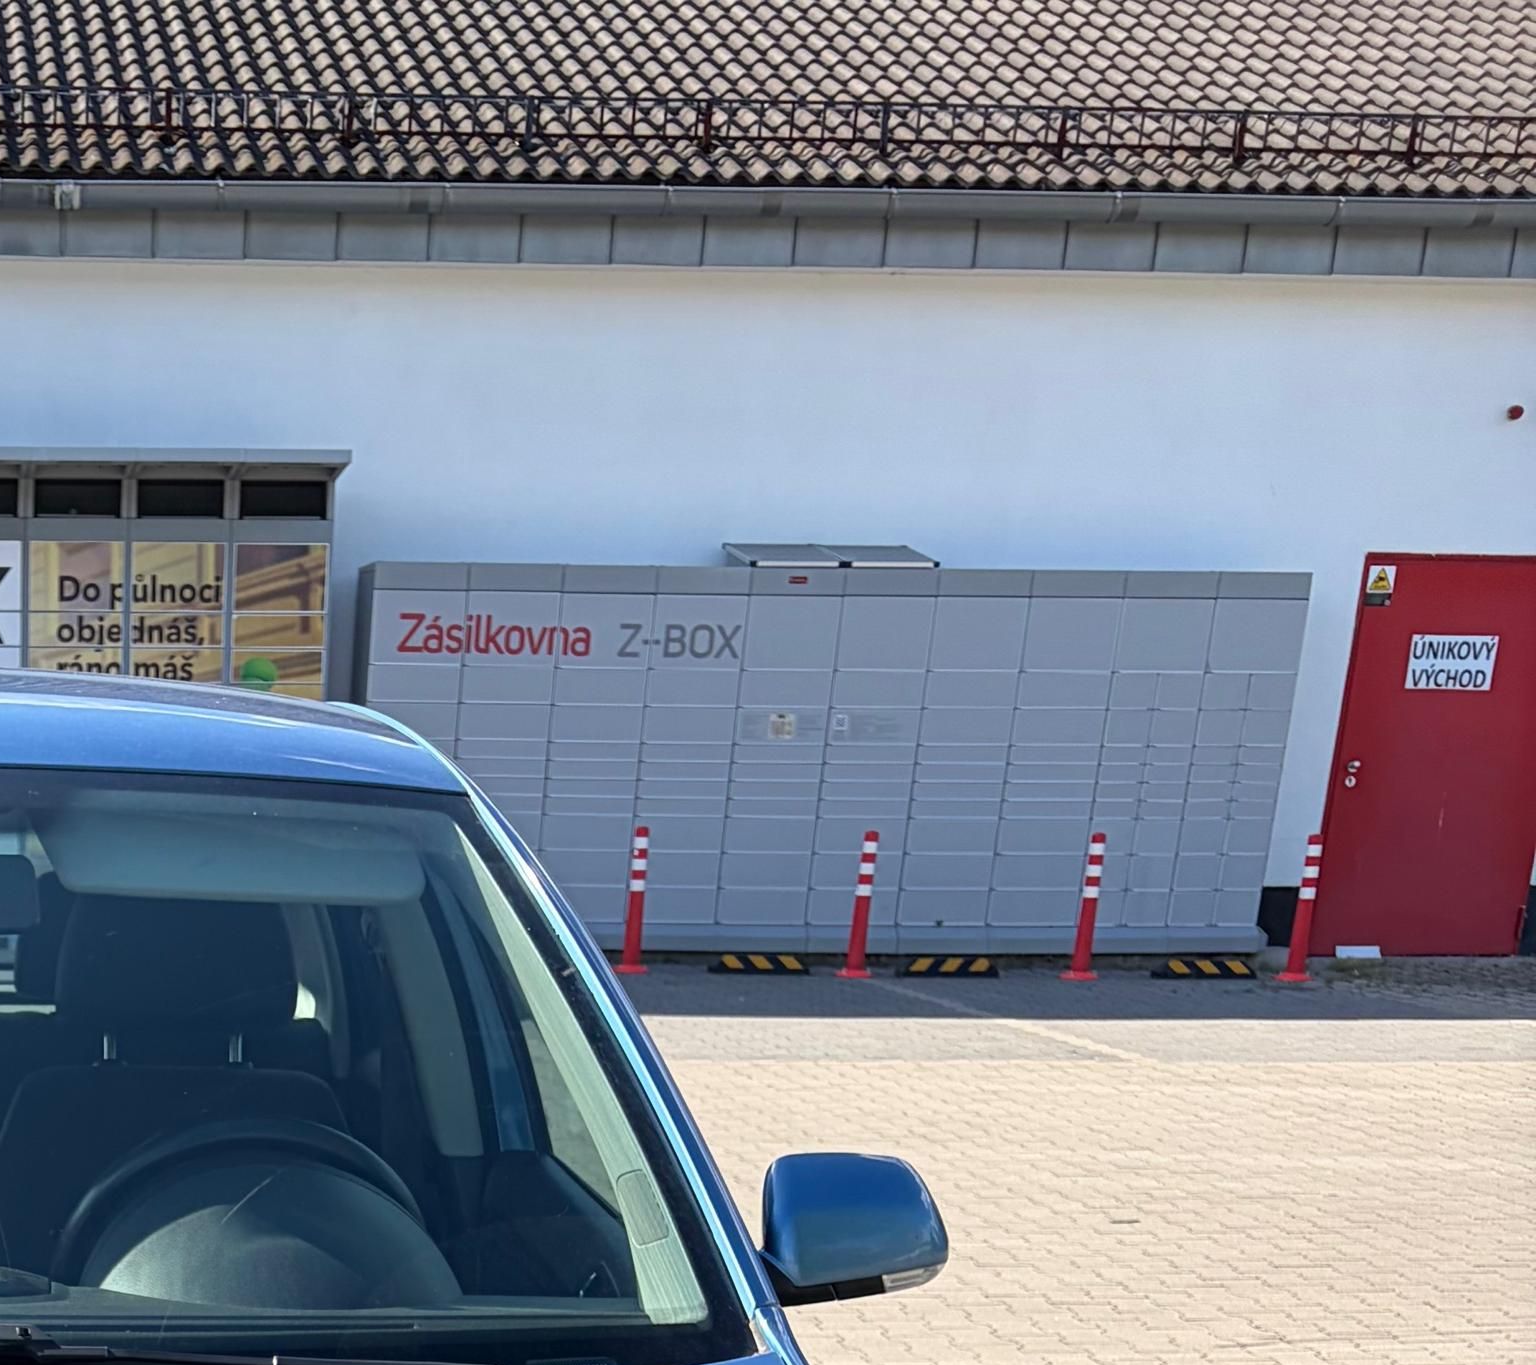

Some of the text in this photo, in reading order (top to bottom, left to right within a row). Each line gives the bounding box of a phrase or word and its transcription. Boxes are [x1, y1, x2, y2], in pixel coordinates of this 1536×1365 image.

[59, 574, 222, 610] Do půlnoci
[57, 615, 205, 651] objednáš,
[397, 612, 592, 657] Zásilkovna
[617, 623, 742, 659] Z-BOX
[1413, 635, 1496, 661] ÚNIKOVÝ
[134, 655, 195, 681] máš
[1411, 664, 1487, 688] VÝCHOD
